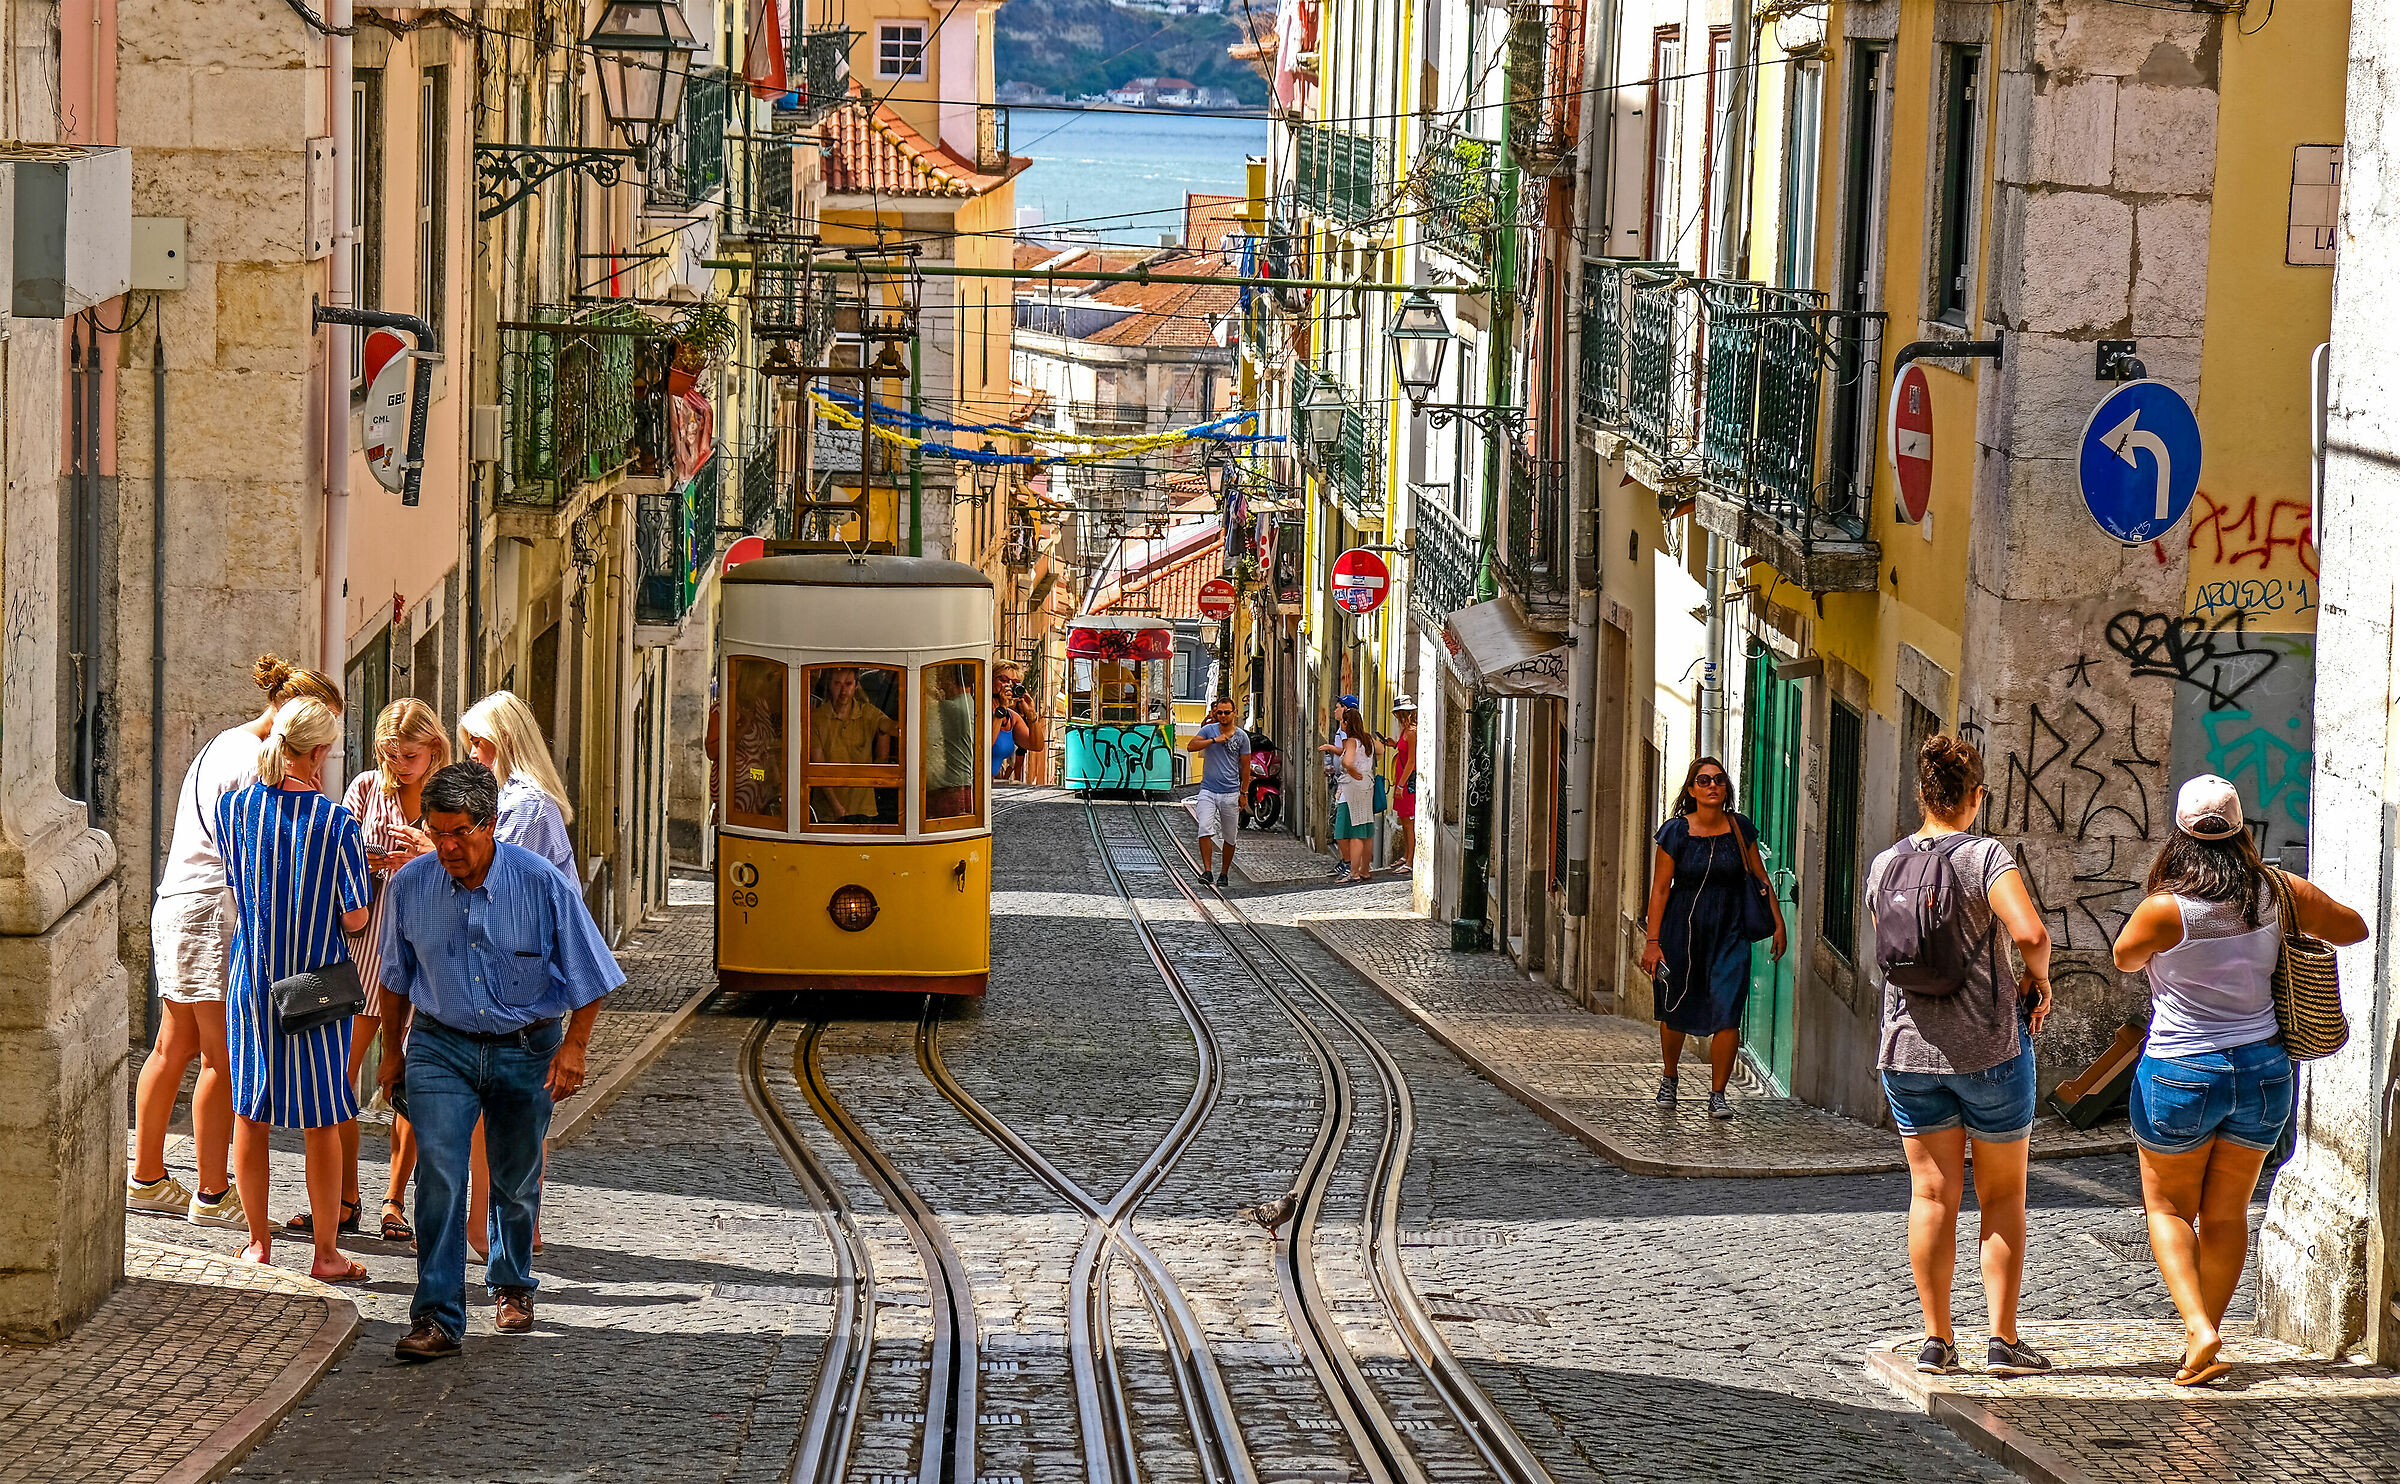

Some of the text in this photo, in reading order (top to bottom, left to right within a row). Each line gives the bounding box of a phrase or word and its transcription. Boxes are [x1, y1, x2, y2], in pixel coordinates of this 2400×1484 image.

[2330, 162, 2342, 184] T
[2315, 228, 2335, 250] LA
[373, 415, 390, 424] CML
